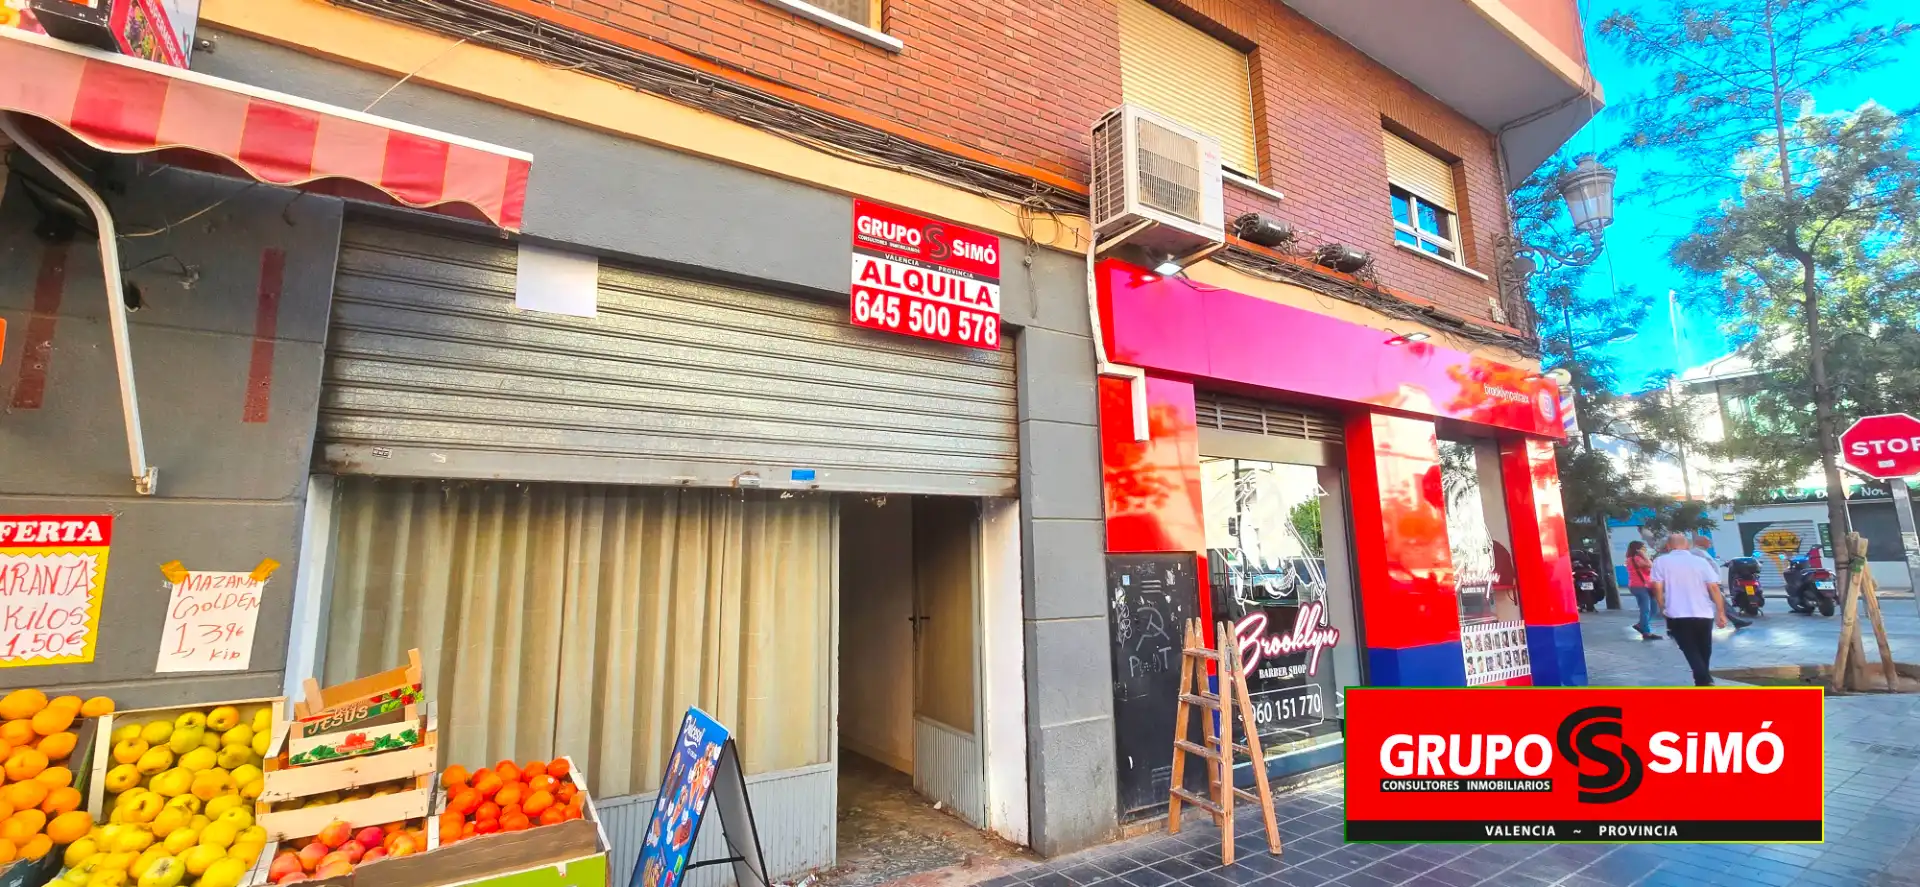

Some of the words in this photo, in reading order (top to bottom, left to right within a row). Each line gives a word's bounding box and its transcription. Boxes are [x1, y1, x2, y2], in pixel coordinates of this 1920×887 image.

[857, 215, 922, 246] GRUPO
[884, 253, 920, 267] VALENCIA
[938, 265, 974, 279] PROVINCIA
[859, 259, 994, 308] ALQUILA
[855, 290, 900, 328] 645
[908, 300, 951, 337] 500
[958, 310, 997, 346] 578
[0, 521, 103, 542] FERTA
[0, 559, 90, 598] ARANJA
[1234, 601, 1340, 677] Brooklyn
[1259, 666, 1287, 679] BARBER
[1288, 664, 1307, 676] SHOP
[308, 705, 369, 735] JESUS
[1275, 697, 1296, 720] 151
[1299, 693, 1321, 716] 770
